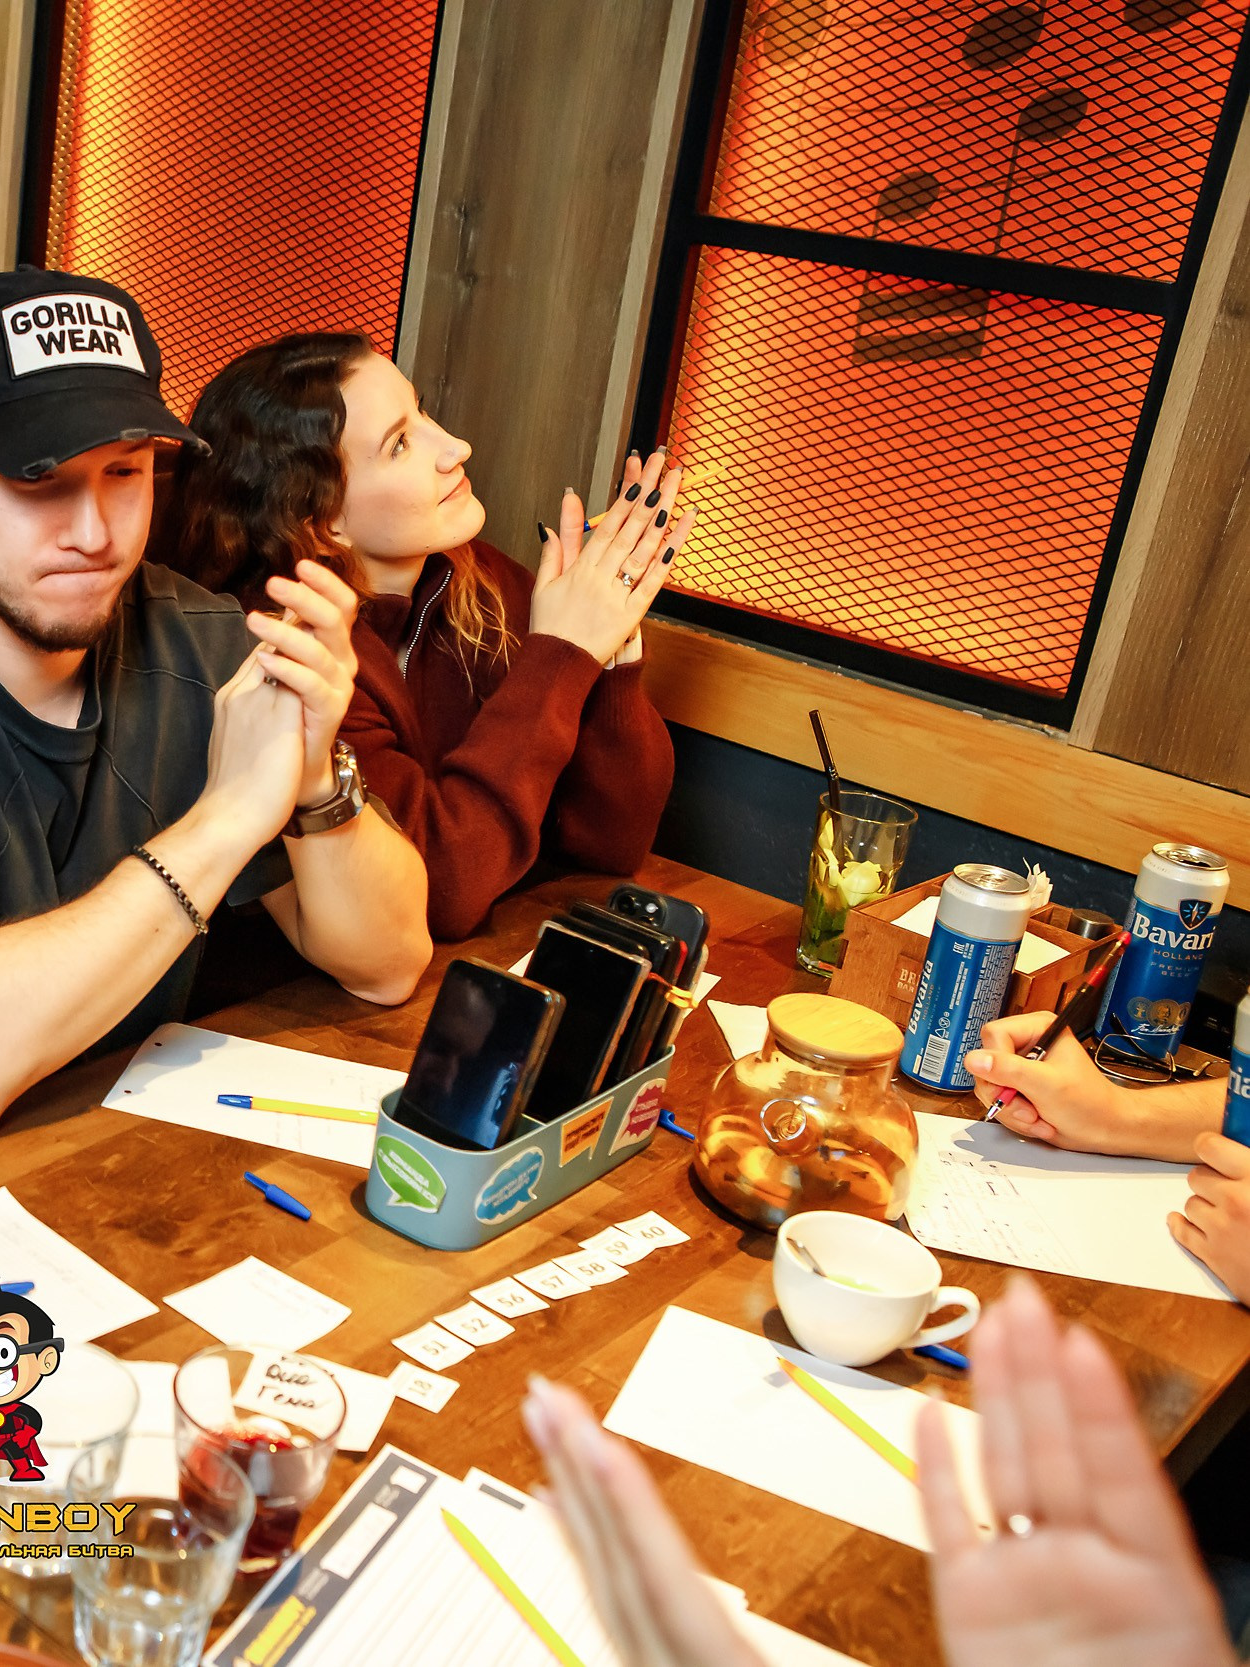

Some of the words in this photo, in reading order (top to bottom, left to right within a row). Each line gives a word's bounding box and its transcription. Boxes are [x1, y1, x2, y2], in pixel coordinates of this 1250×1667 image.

[10, 302, 131, 336] GORILLA
[36, 329, 123, 356] WEAR
[1132, 912, 1217, 951] Bavari
[907, 959, 934, 1035] Bavaria
[640, 1225, 665, 1240] 60
[606, 1241, 629, 1256] 59
[578, 1262, 605, 1277] 58
[541, 1275, 565, 1289] 57
[498, 1293, 525, 1308] 56
[461, 1318, 489, 1333] 52
[422, 1340, 449, 1356] 51
